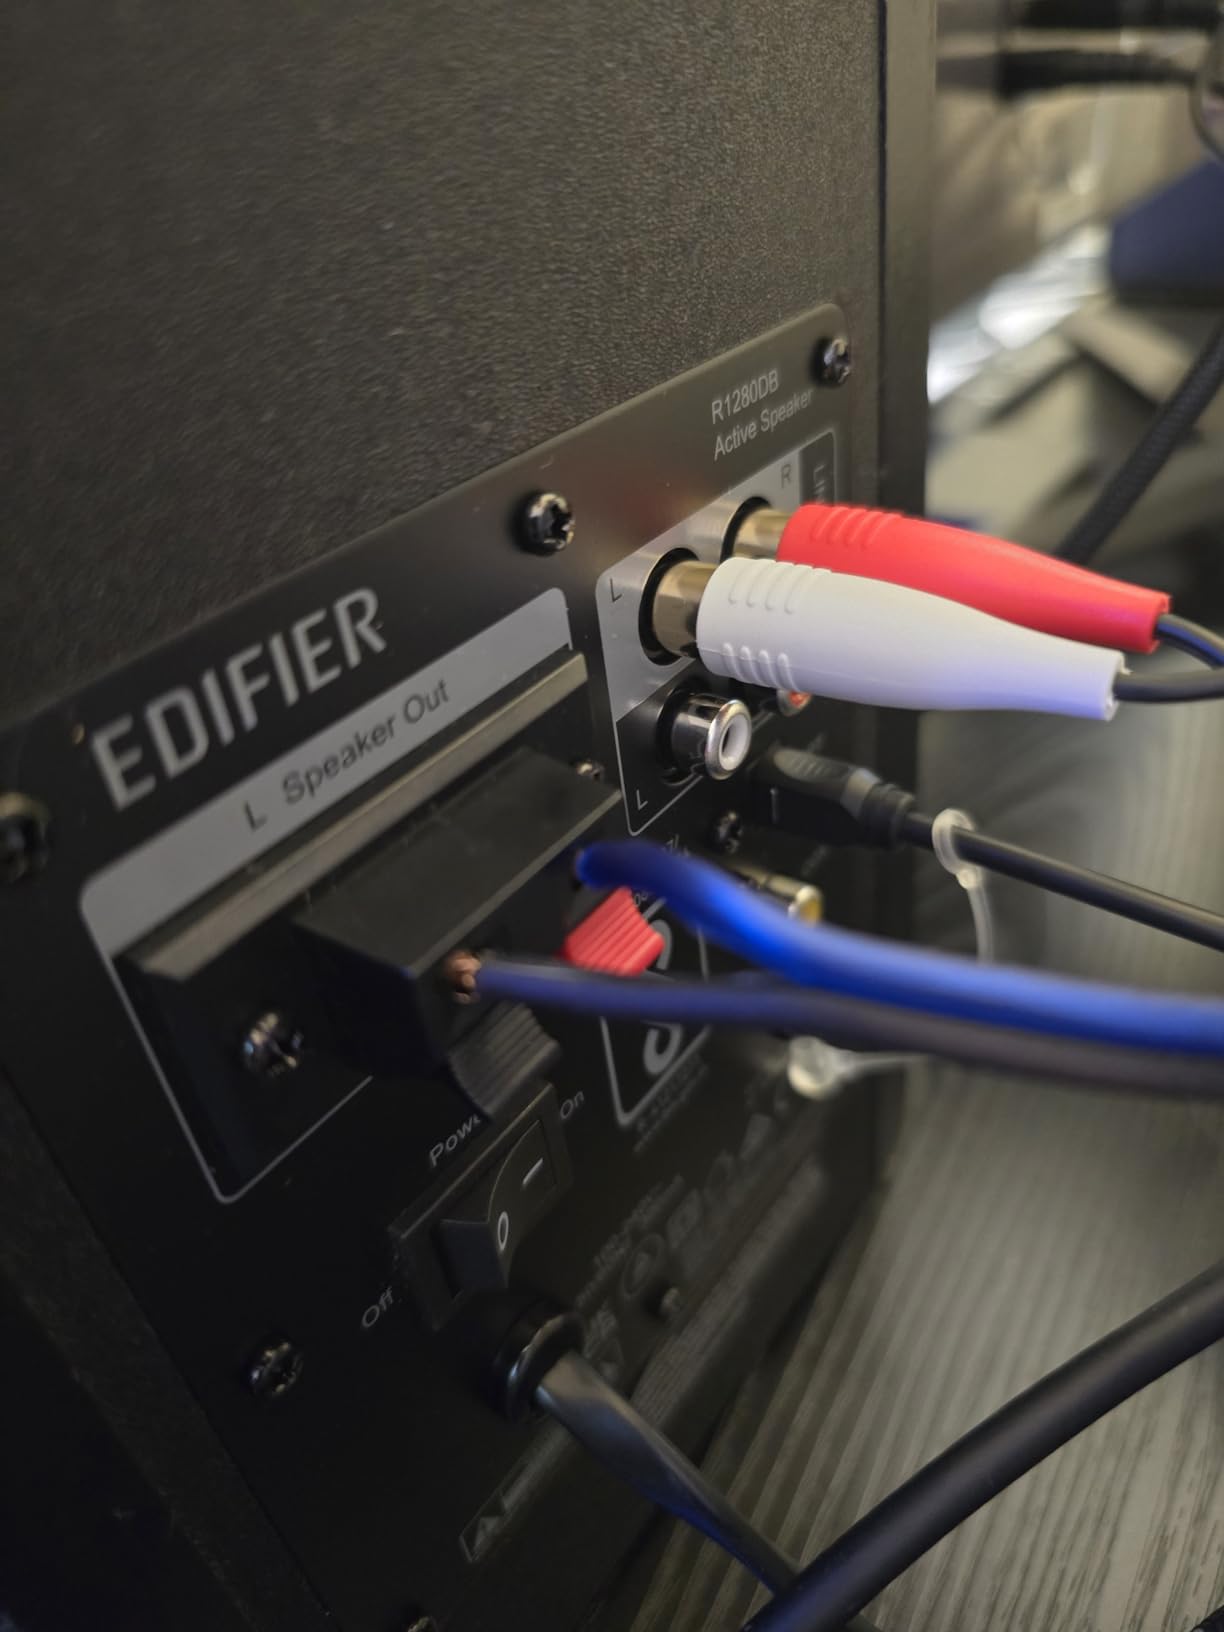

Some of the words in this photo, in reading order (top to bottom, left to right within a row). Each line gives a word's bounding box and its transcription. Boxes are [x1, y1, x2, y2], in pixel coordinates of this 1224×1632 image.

[711, 369, 779, 424] R1280DB
[714, 421, 757, 460] Active
[761, 389, 813, 432] Speaker
[781, 464, 791, 488] R
[610, 578, 622, 602] L
[91, 587, 387, 810] EDIFIER
[243, 803, 267, 830] L
[281, 716, 397, 804] Speaker
[404, 680, 450, 724] Out
[636, 789, 648, 810] L
[560, 1091, 584, 1120] On
[362, 1286, 394, 1328] Off
